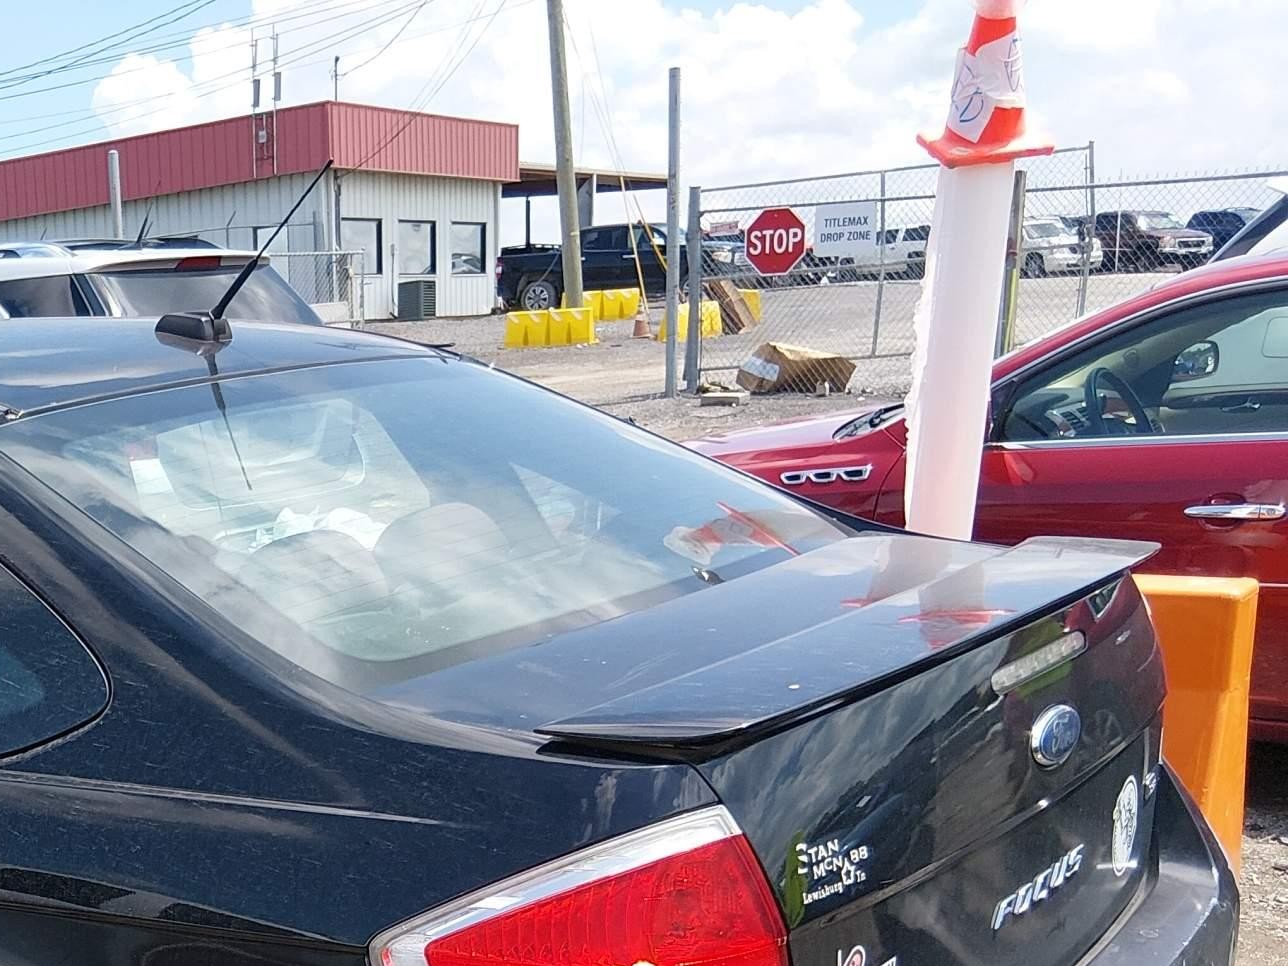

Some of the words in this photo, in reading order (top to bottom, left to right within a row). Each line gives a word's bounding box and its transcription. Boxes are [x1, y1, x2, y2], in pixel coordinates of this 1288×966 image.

[824, 215, 869, 228] TITLEMAX
[749, 228, 802, 256] STOP
[820, 232, 844, 243] DROP
[847, 230, 871, 241] ZONE
[796, 838, 839, 874] STAN
[991, 844, 1084, 929] FOCUS
